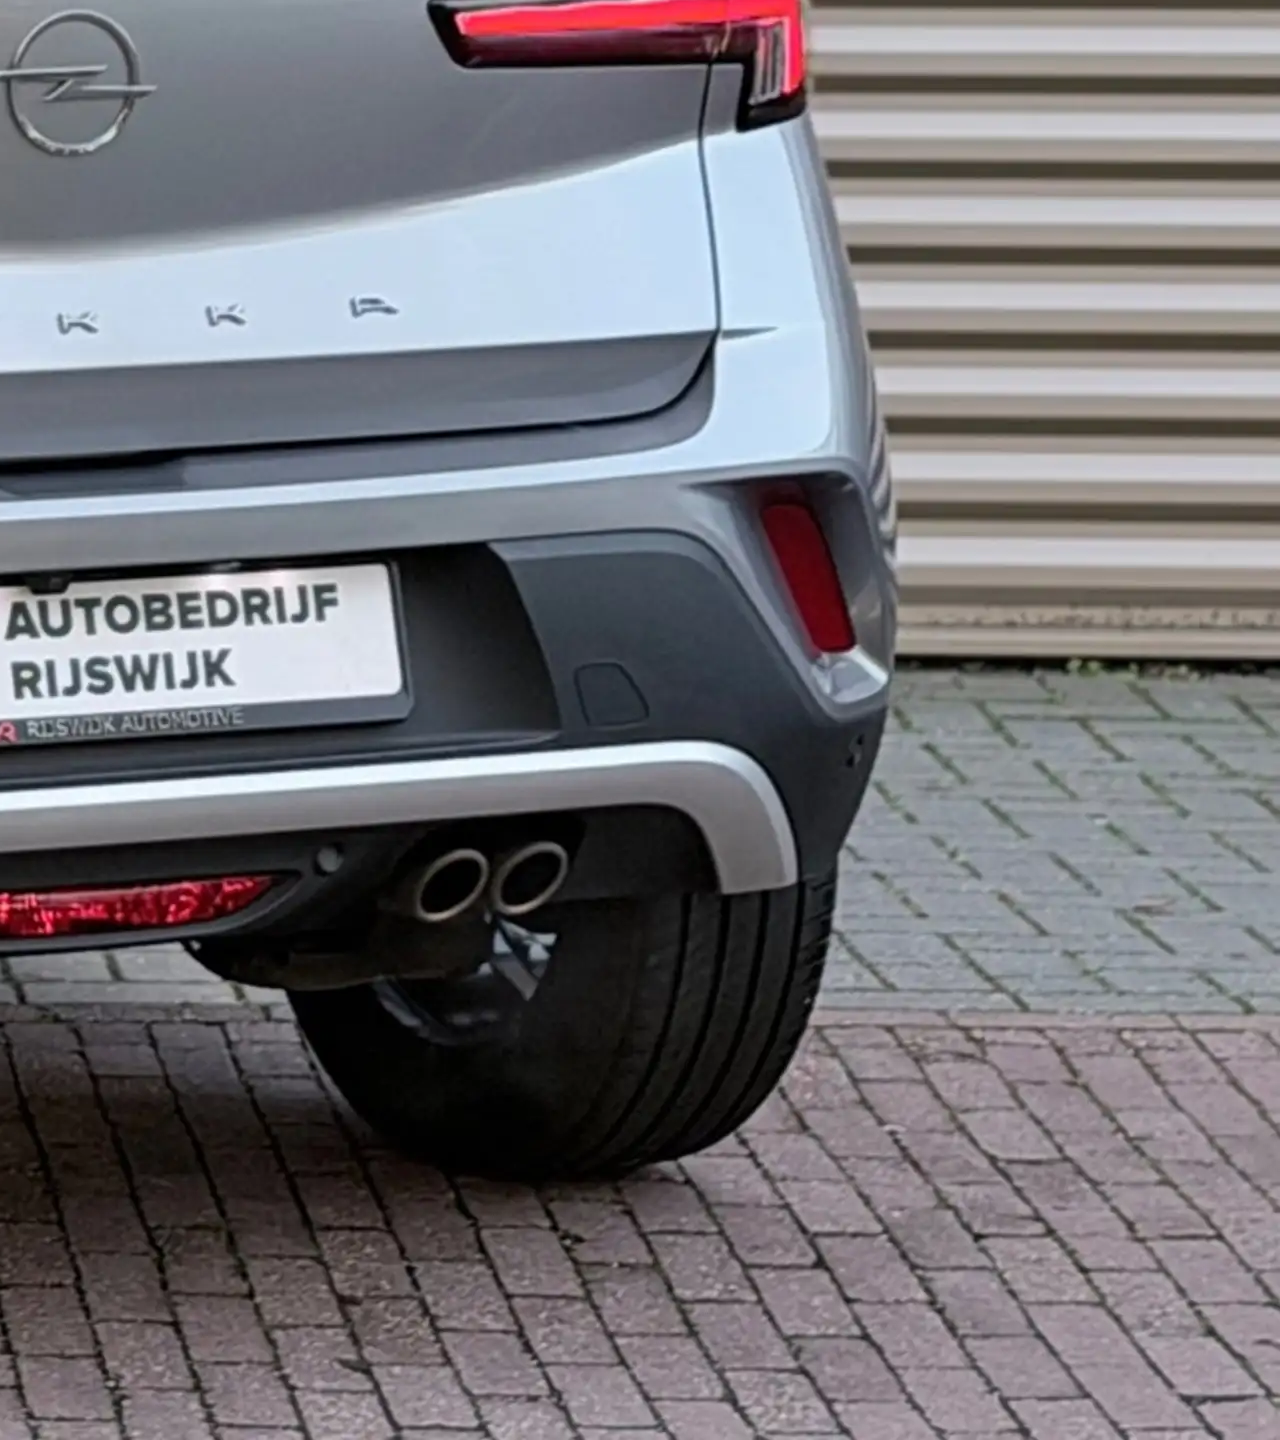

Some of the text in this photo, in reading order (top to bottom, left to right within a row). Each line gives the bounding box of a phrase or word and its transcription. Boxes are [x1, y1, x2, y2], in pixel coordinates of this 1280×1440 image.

[4, 583, 339, 641] AUTOBEDRIJF
[11, 648, 235, 700] RIJSWIJK
[120, 707, 244, 732] AUTOMOTIVE
